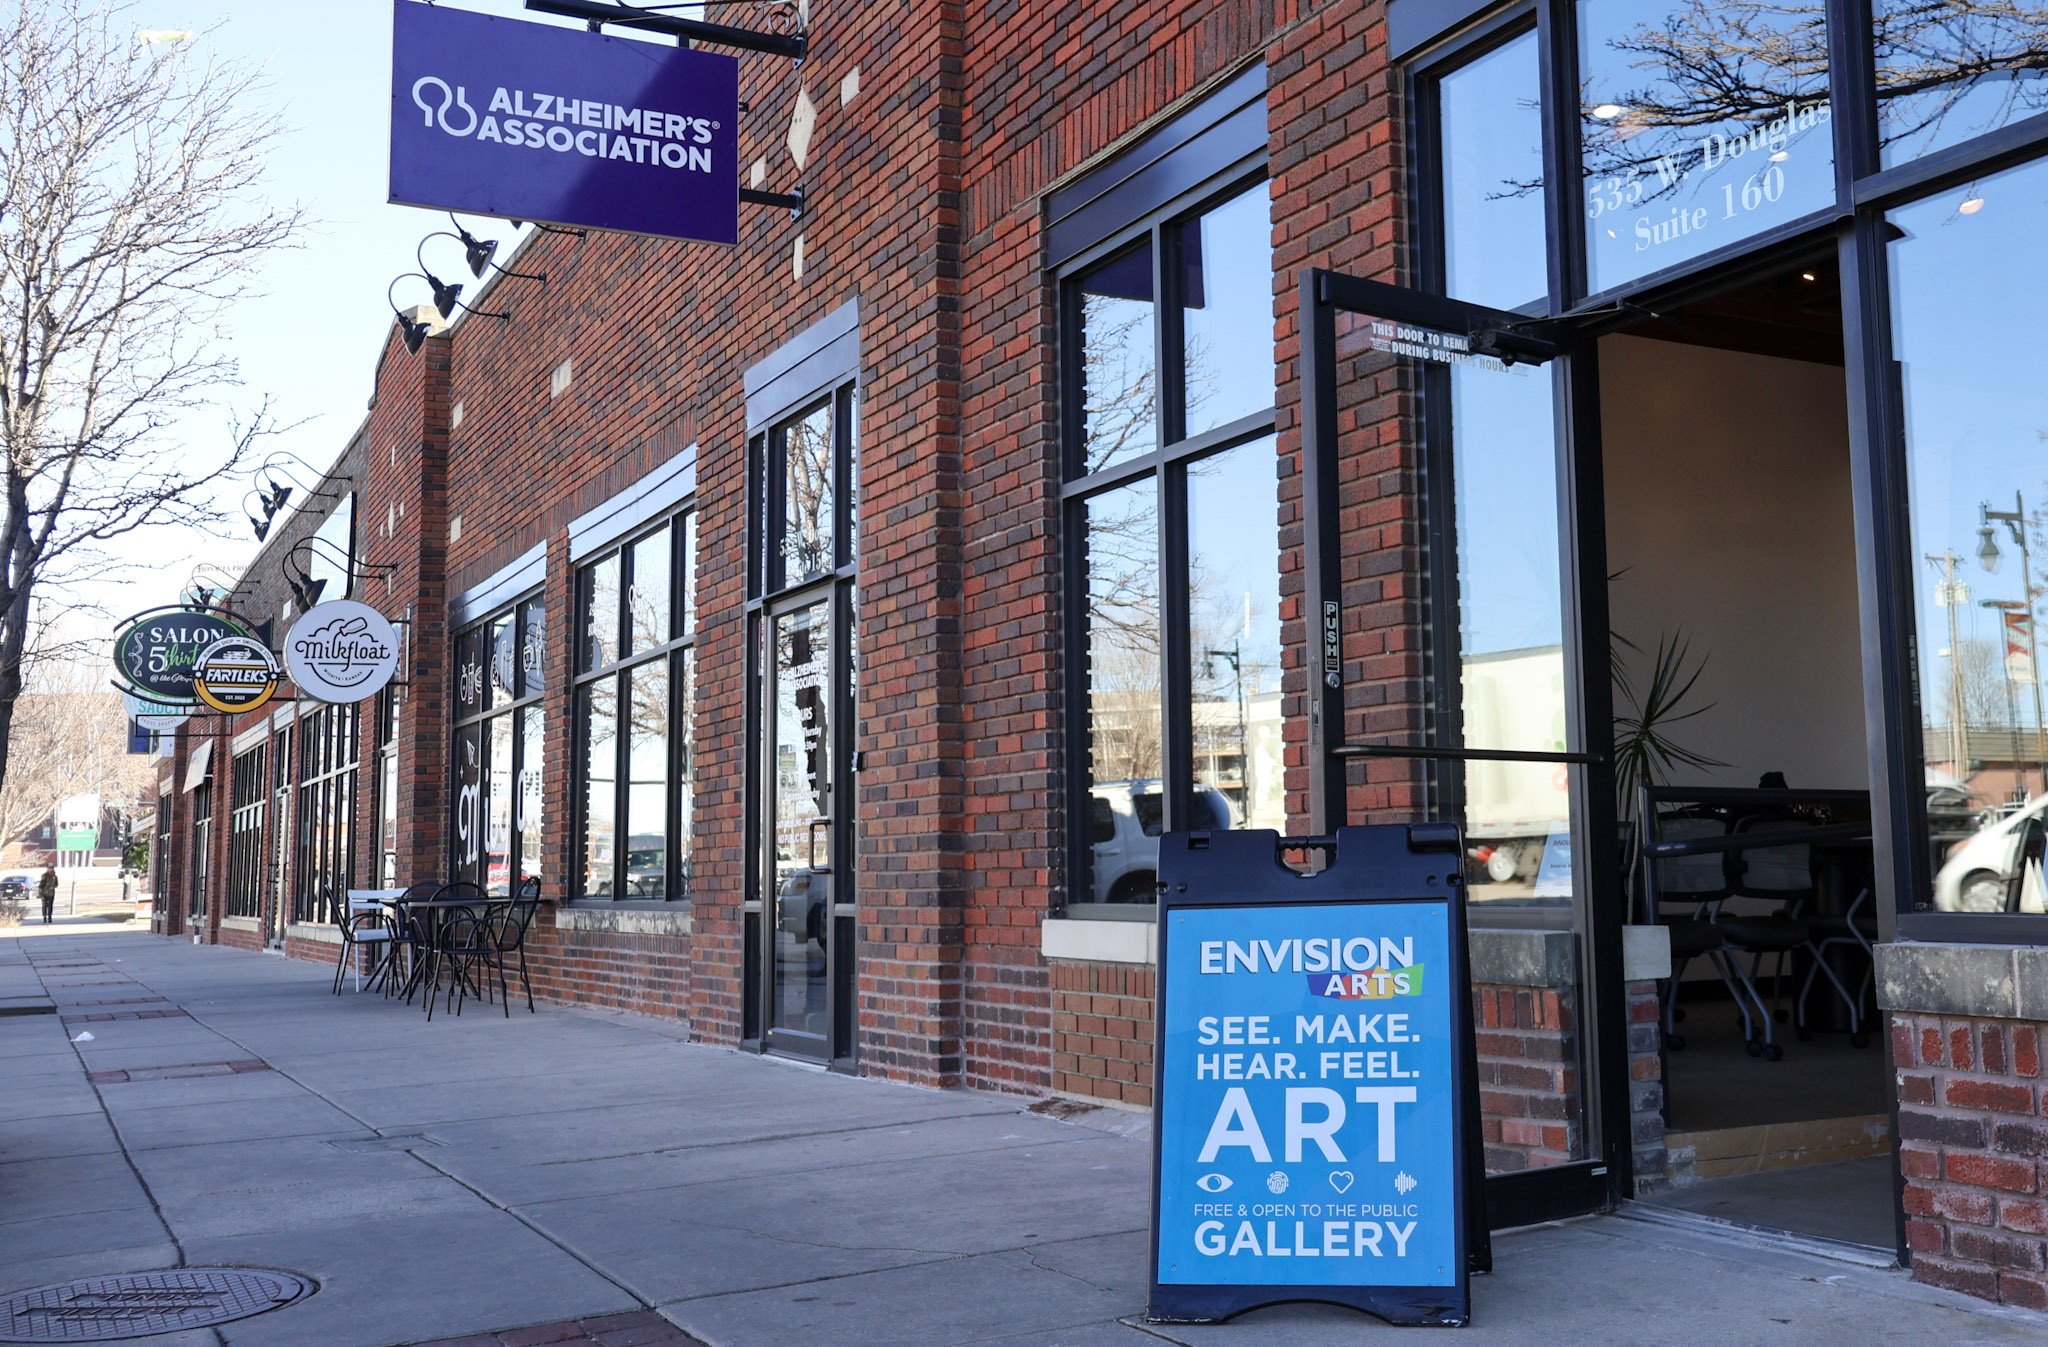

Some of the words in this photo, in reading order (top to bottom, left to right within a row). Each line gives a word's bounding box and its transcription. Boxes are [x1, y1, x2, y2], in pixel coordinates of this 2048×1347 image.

[488, 87, 713, 145] ALZHEIMER'S
[477, 115, 712, 174] ASSOCIATION
[1588, 166, 1643, 219] 535
[1654, 151, 1689, 187] W.
[1701, 96, 1833, 174] Douglas
[1634, 206, 1708, 253] Suite
[1721, 167, 1785, 221] 160
[1371, 322, 1394, 337] THIS
[1397, 327, 1424, 343] DOOR
[1427, 333, 1440, 346] TO
[1443, 336, 1469, 352] REMA
[1392, 341, 1430, 359] DURING
[1432, 349, 1476, 367] BUSINESS
[1480, 358, 1509, 373] HOURS
[150, 627, 224, 644] SALON
[1326, 604, 1337, 657] PUSH
[148, 643, 200, 673] 5thirt
[242, 639, 264, 653] SMOOTHIE
[263, 650, 273, 662] STOP
[205, 668, 269, 683] FARTLEKS
[324, 668, 341, 681] WICHITA
[345, 671, 363, 681] KANSAS
[1200, 937, 1414, 974] ENVISION
[1324, 973, 1411, 997] ARTS
[1198, 1016, 1281, 1045] SEE.
[1295, 1014, 1420, 1043] MAKE.
[1197, 1053, 1306, 1080] HEAR.
[1320, 1052, 1420, 1079] FEEL.
[1198, 1086, 1417, 1163] ART
[1194, 1204, 1233, 1217] FREE
[1237, 1204, 1248, 1217] &
[1253, 1204, 1295, 1217] OPEN
[1301, 1204, 1321, 1217] TO
[1327, 1204, 1356, 1217] THE
[1361, 1204, 1418, 1217] PUBLIC
[1194, 1221, 1418, 1257] GALLERY
